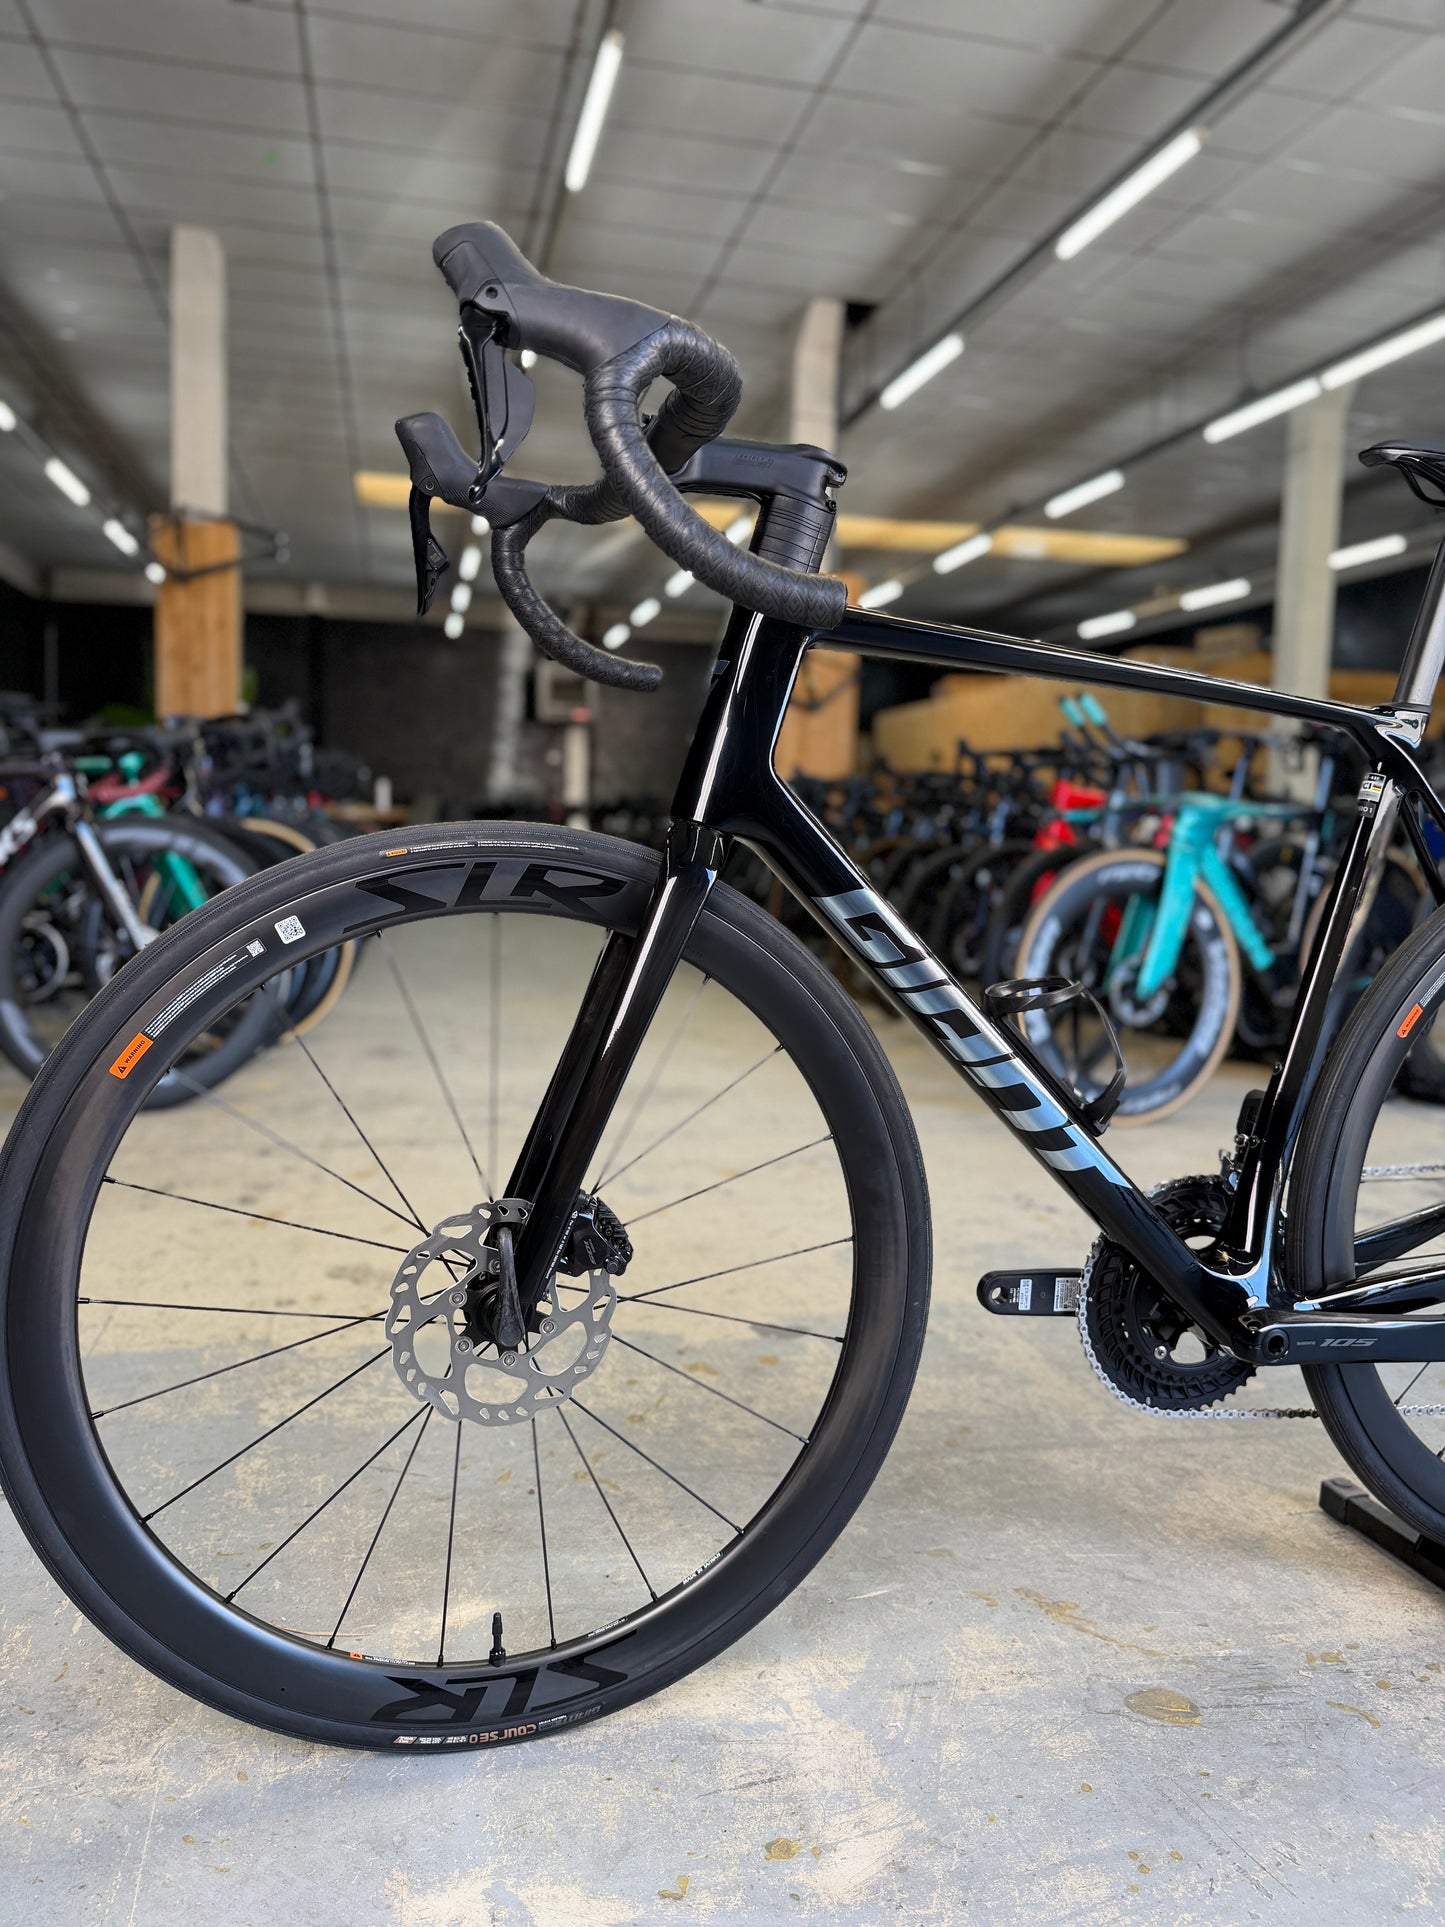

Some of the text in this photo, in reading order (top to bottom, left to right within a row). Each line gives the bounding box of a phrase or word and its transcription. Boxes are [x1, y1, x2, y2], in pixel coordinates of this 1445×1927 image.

[342, 861, 629, 935] SLR
[124, 1040, 146, 1064] WARNING
[811, 888, 1132, 1188] GIANT
[1320, 1338, 1378, 1347] 105
[370, 1628, 637, 1724] SLR
